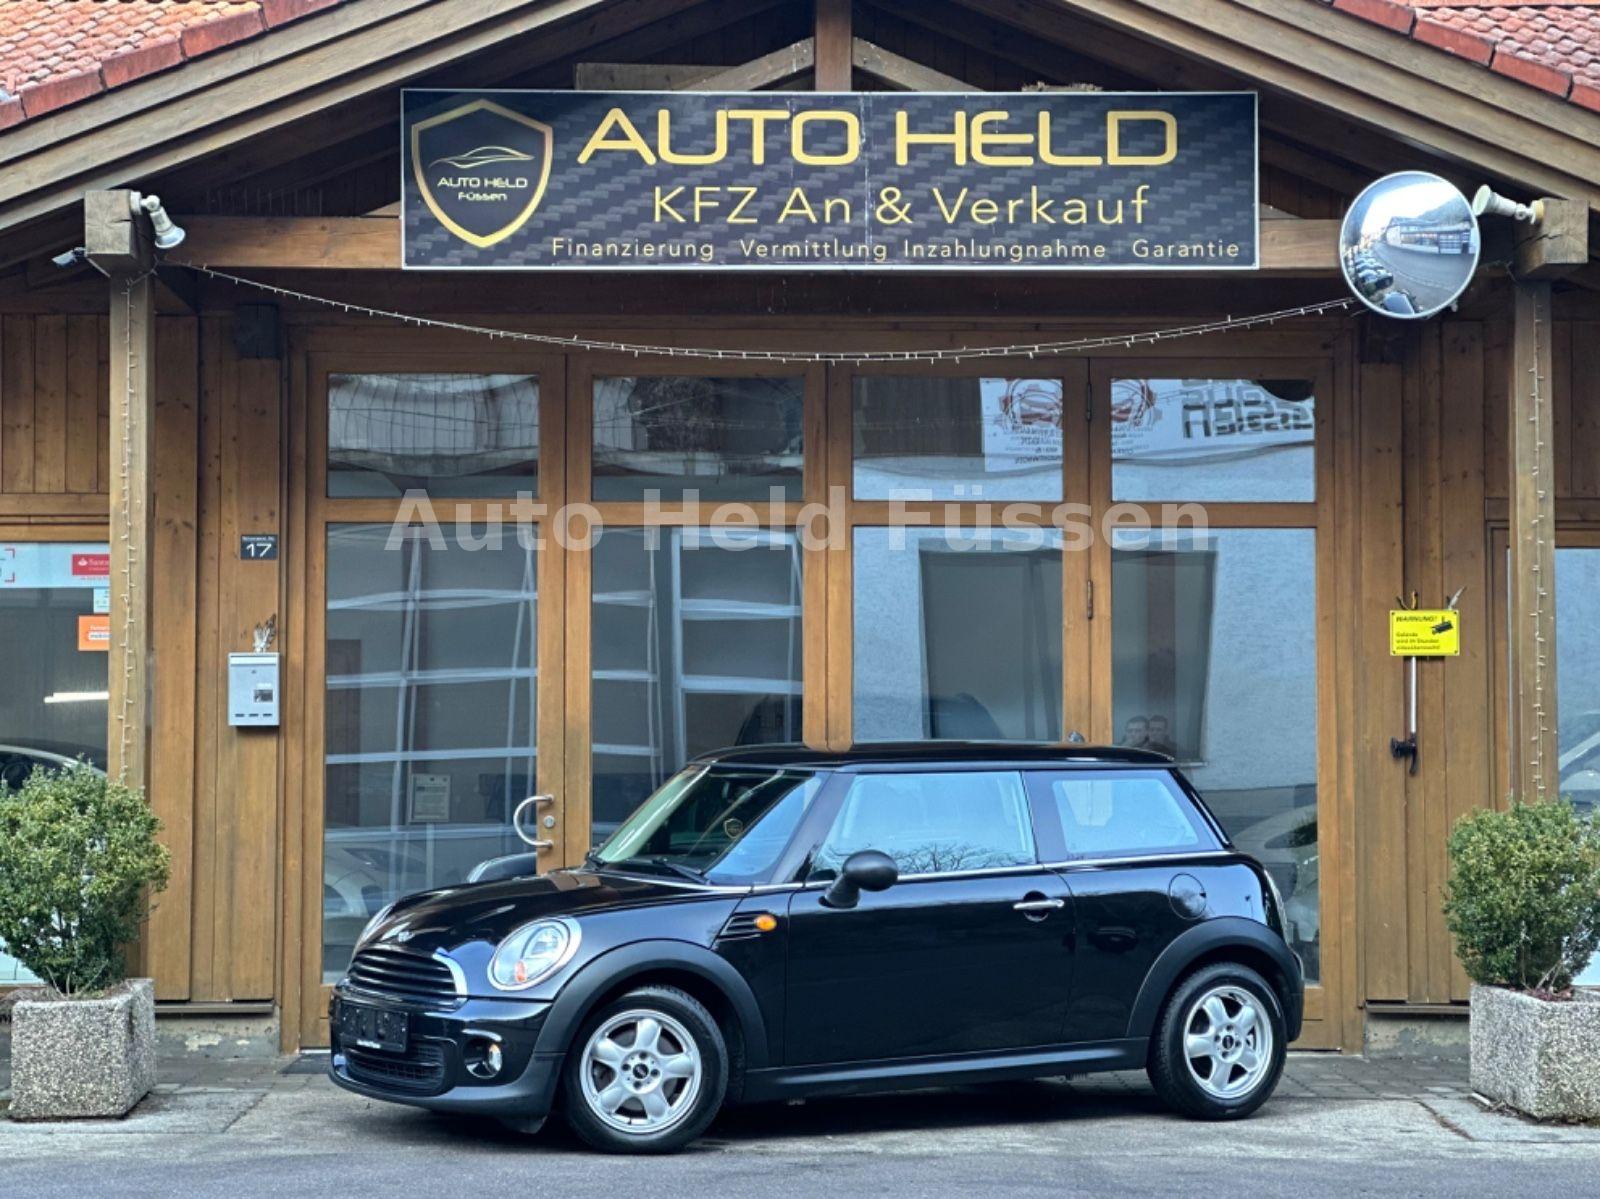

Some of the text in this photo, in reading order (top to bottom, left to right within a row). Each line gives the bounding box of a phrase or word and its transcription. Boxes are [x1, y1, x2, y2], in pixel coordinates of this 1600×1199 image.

[577, 107, 1178, 166] AUTO HELD
[437, 176, 528, 189] AUTO HELD
[653, 184, 1151, 225] KFZ An & Verkauf
[552, 237, 1240, 262] Finanzierung Vermittlung Inzahlungnahme Garantie
[246, 543, 272, 558] 17
